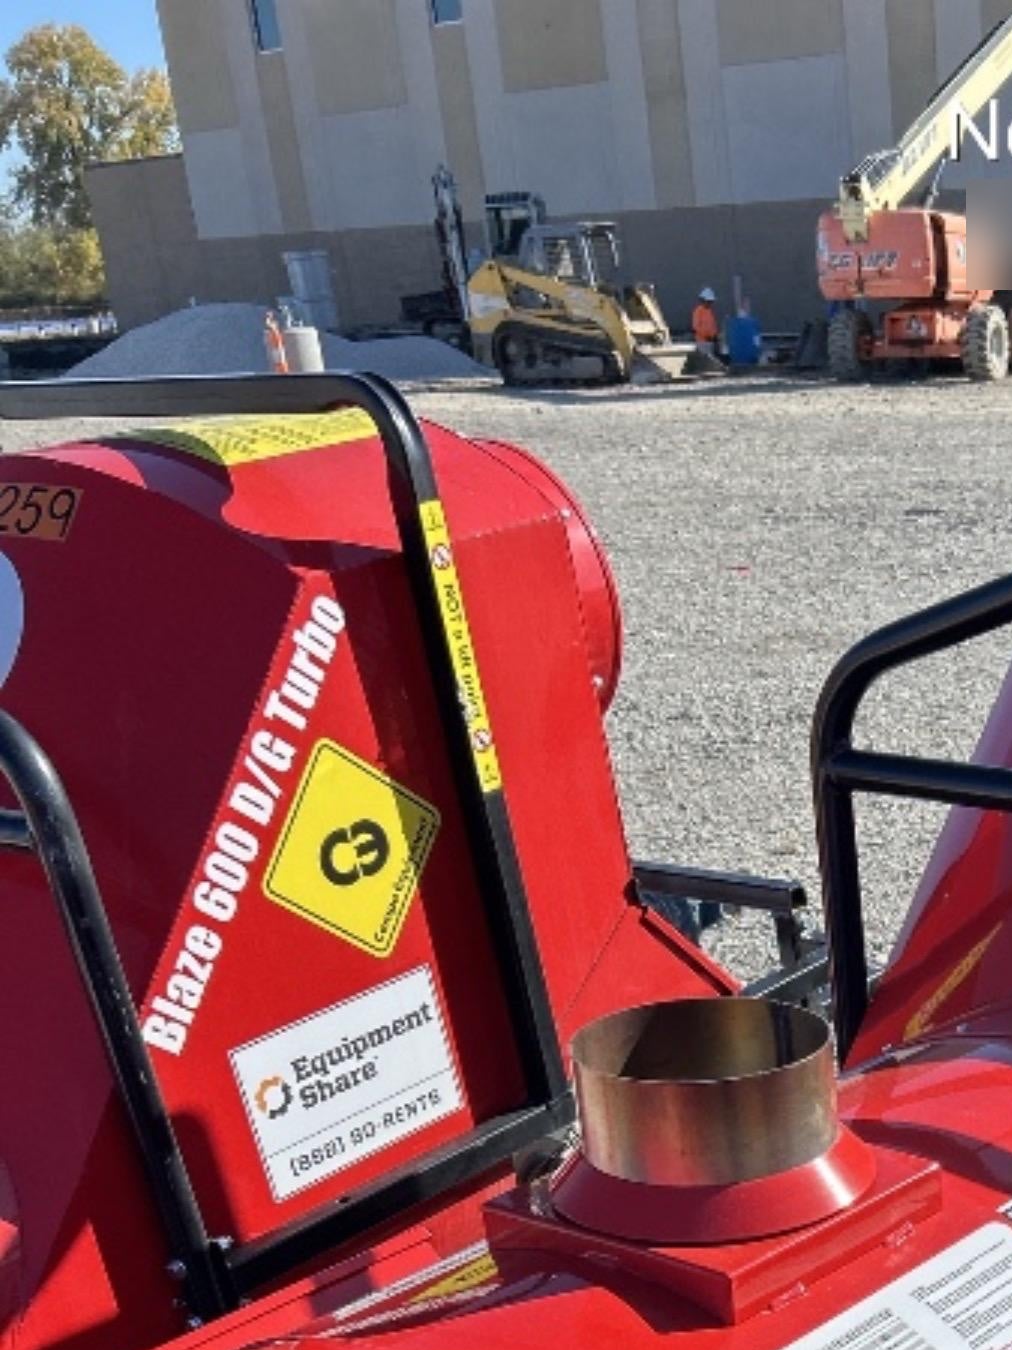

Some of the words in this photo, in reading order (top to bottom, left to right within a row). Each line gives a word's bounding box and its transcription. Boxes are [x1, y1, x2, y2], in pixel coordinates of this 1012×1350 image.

[443, 582, 463, 623] NOT
[142, 923, 224, 1057] Blaze
[193, 820, 260, 923] 600
[229, 729, 298, 827] D/G
[264, 595, 346, 731] Turbo
[290, 1001, 433, 1084] Equipment
[299, 1060, 378, 1110] Share
